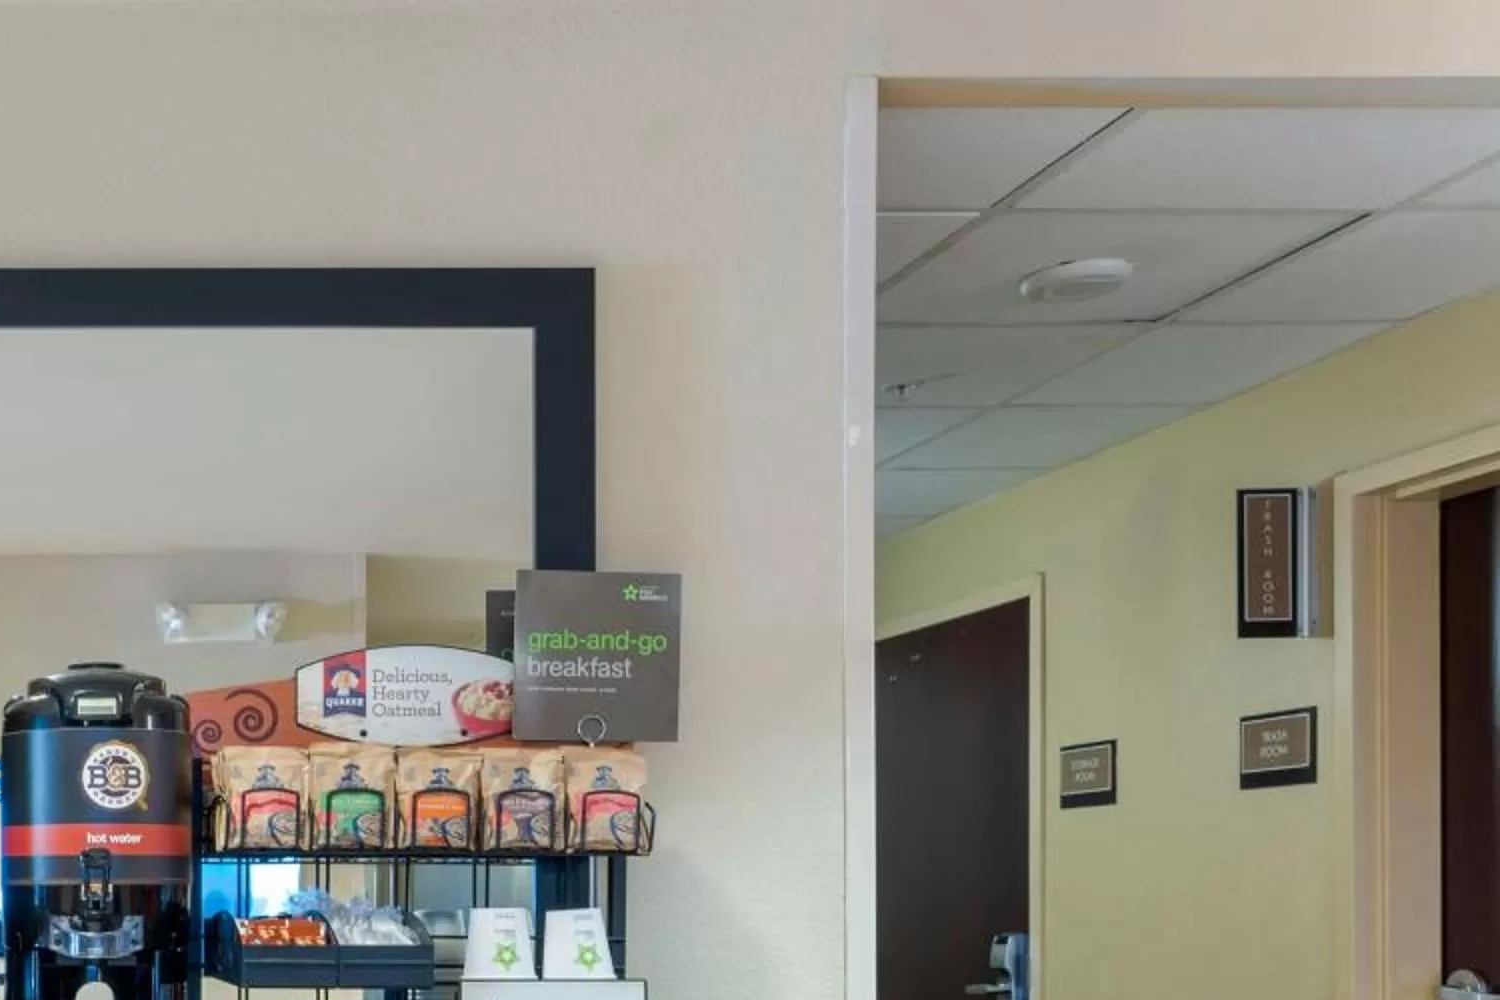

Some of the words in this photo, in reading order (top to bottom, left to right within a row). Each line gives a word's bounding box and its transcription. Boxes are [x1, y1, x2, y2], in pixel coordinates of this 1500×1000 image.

[527, 628, 668, 656] grab-and-go
[527, 655, 633, 679] breakfast
[372, 667, 453, 686] Delicious,
[325, 697, 365, 709] QUAKER
[372, 685, 430, 703] Hearty
[372, 702, 442, 718] Oatmeal
[86, 832, 108, 844] hot
[109, 833, 142, 844] water
